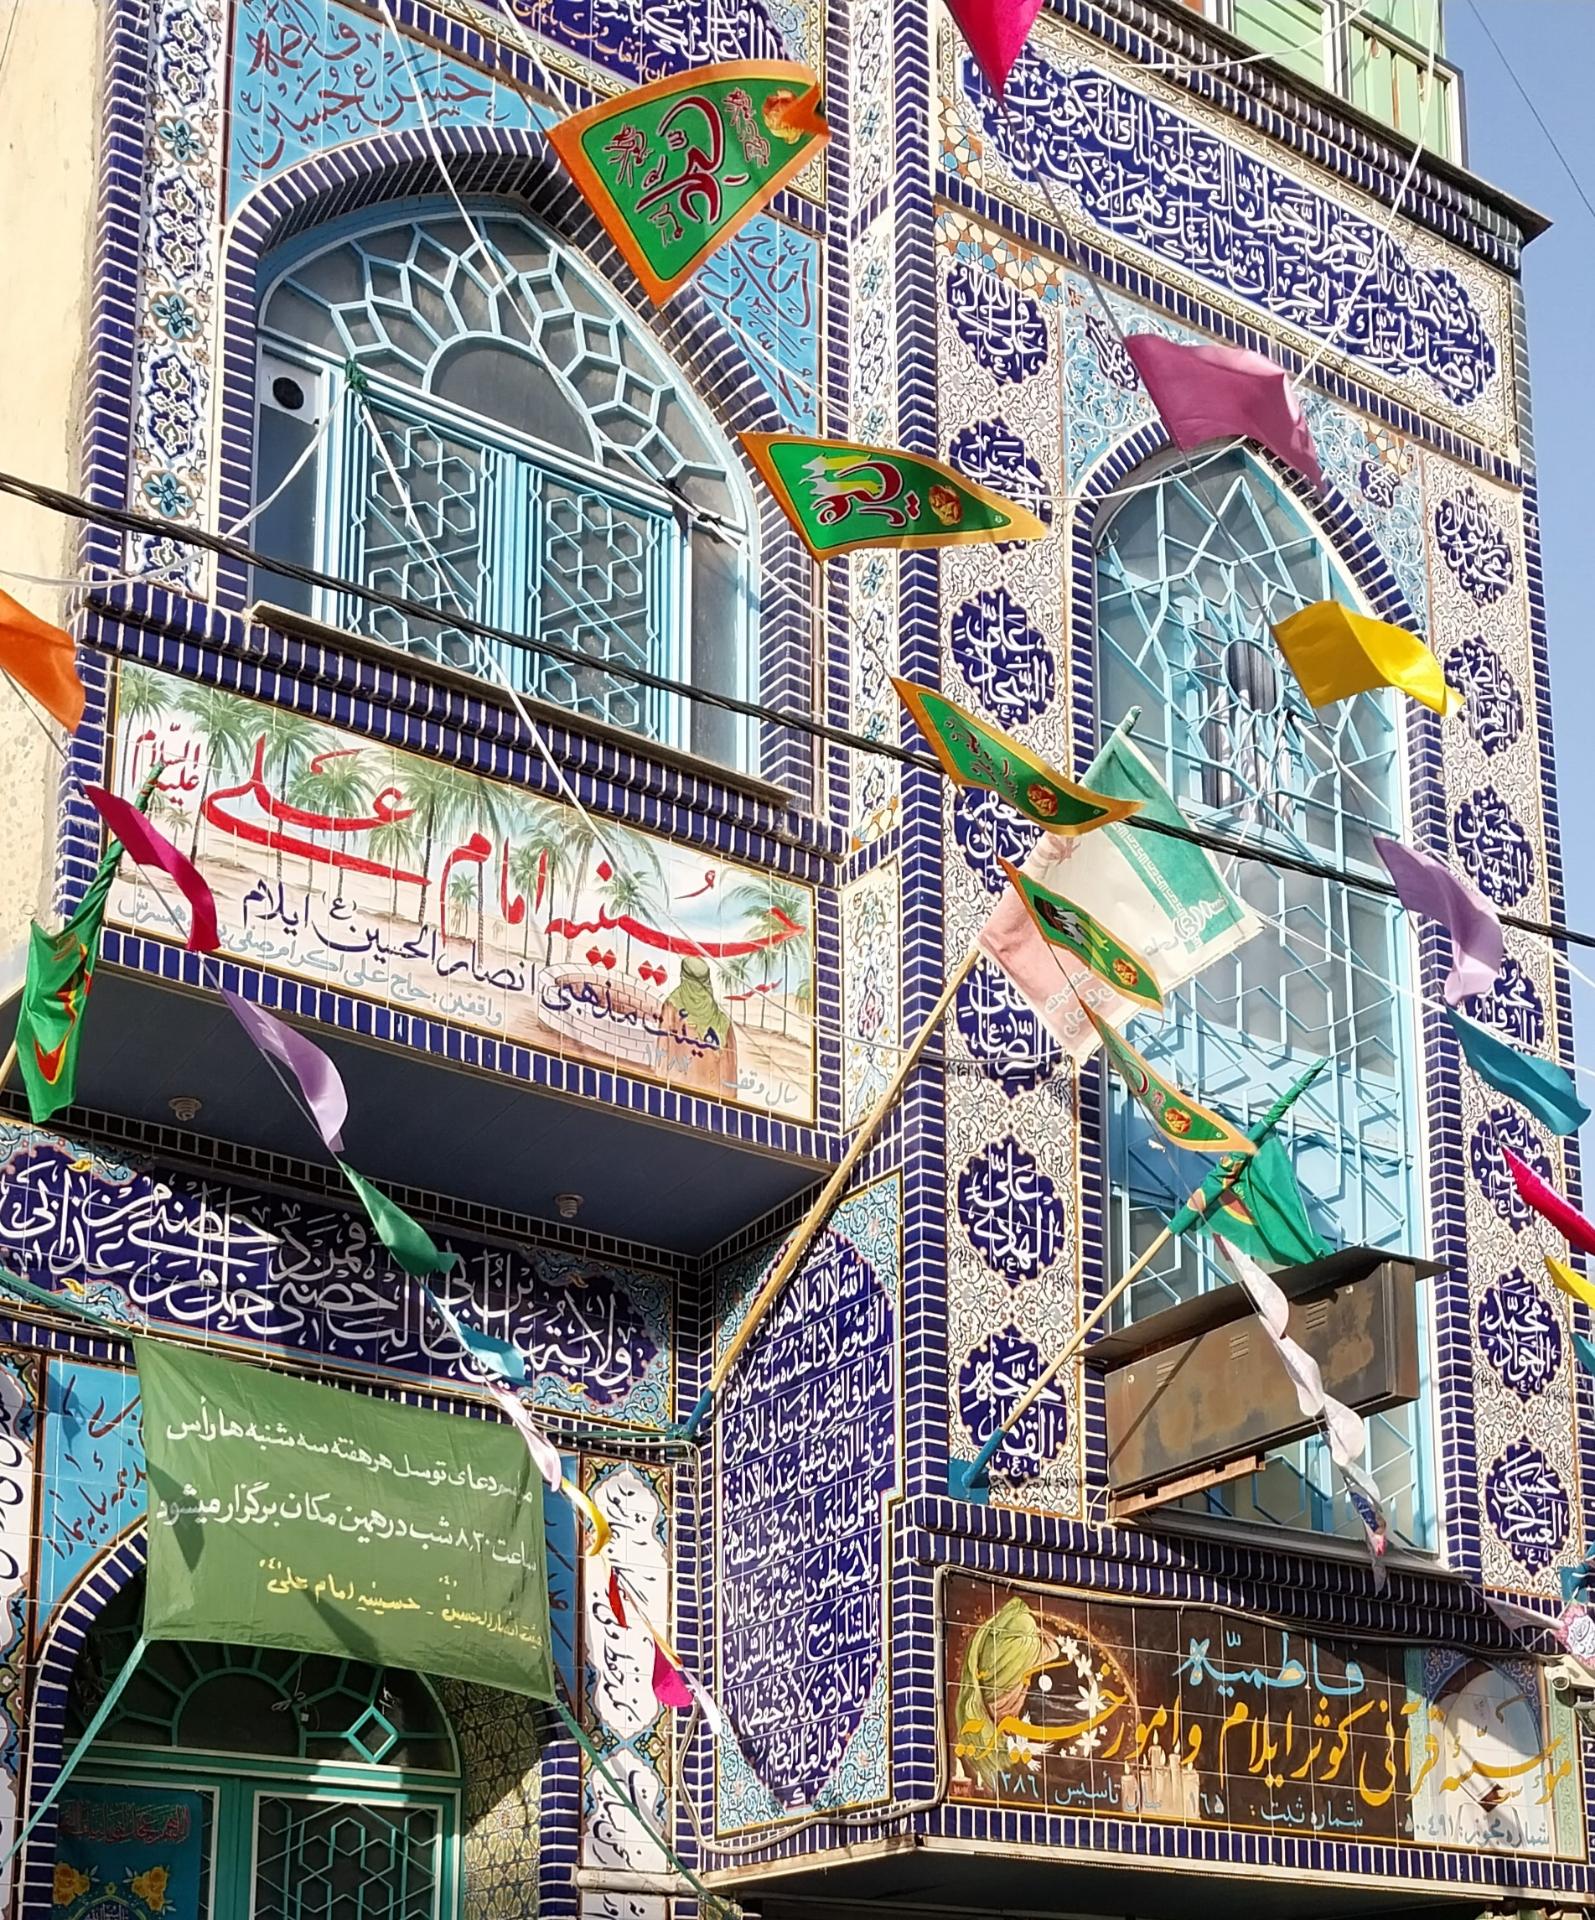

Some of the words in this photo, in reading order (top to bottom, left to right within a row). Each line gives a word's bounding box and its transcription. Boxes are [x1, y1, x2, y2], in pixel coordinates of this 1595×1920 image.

[200, 733, 430, 885] علی
[242, 878, 310, 936] ایلام
[440, 833, 549, 946] امام
[311, 922, 437, 966] الحسین
[546, 862, 806, 986] حسینیه
[344, 958, 390, 987] علی
[389, 972, 431, 1001] حاج
[436, 941, 536, 998] انصار
[541, 979, 639, 1027] مذهبی
[393, 1454, 447, 1486] توسل
[221, 1483, 282, 1527] برگزار
[280, 1492, 337, 1531] مکان
[409, 1515, 453, 1550] شب
[492, 1540, 538, 1571] ساعت
[316, 1572, 354, 1602] امام
[1219, 1701, 1293, 1790] ایلام
[1291, 1695, 1376, 1780] کوثر
[1311, 1800, 1364, 1830] شماره
